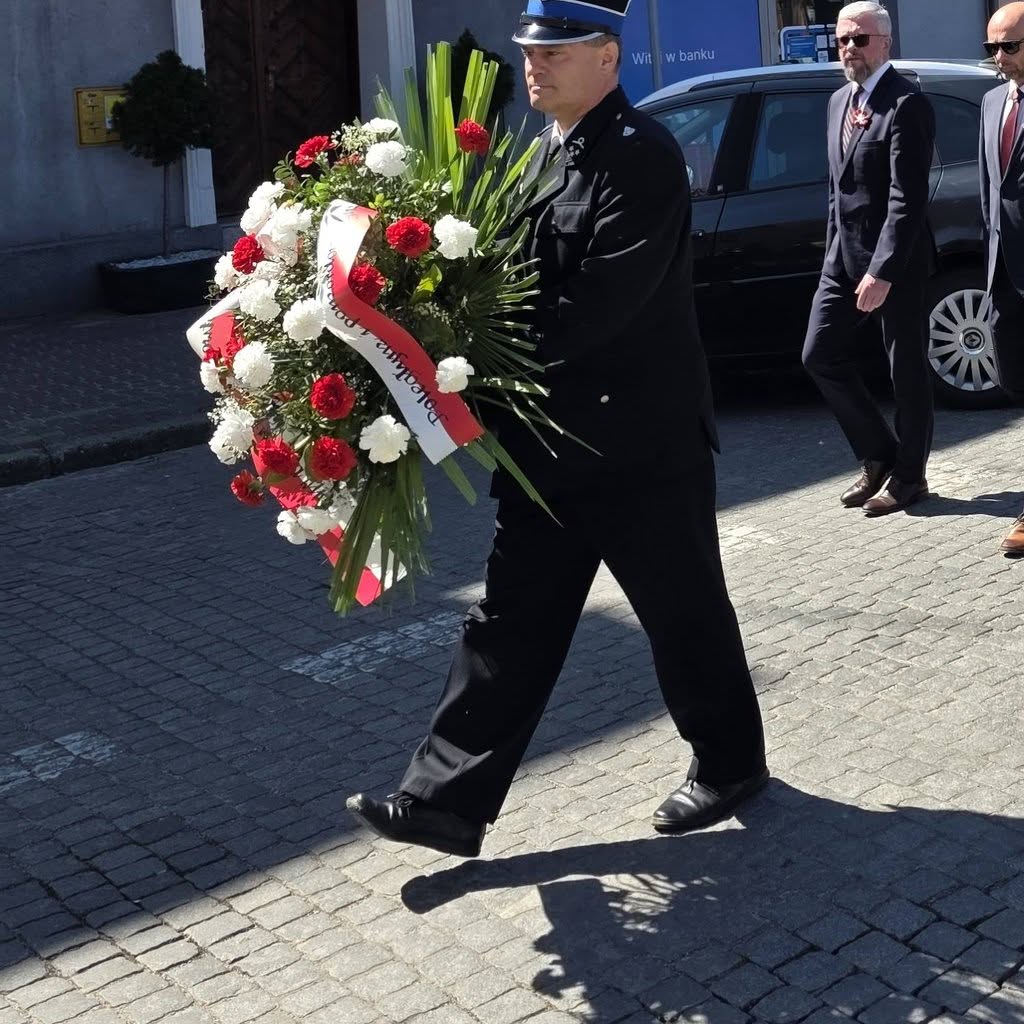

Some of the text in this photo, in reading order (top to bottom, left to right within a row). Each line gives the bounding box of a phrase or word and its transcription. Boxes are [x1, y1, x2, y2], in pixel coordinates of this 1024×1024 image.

[632, 48, 715, 65] Wit w banku
